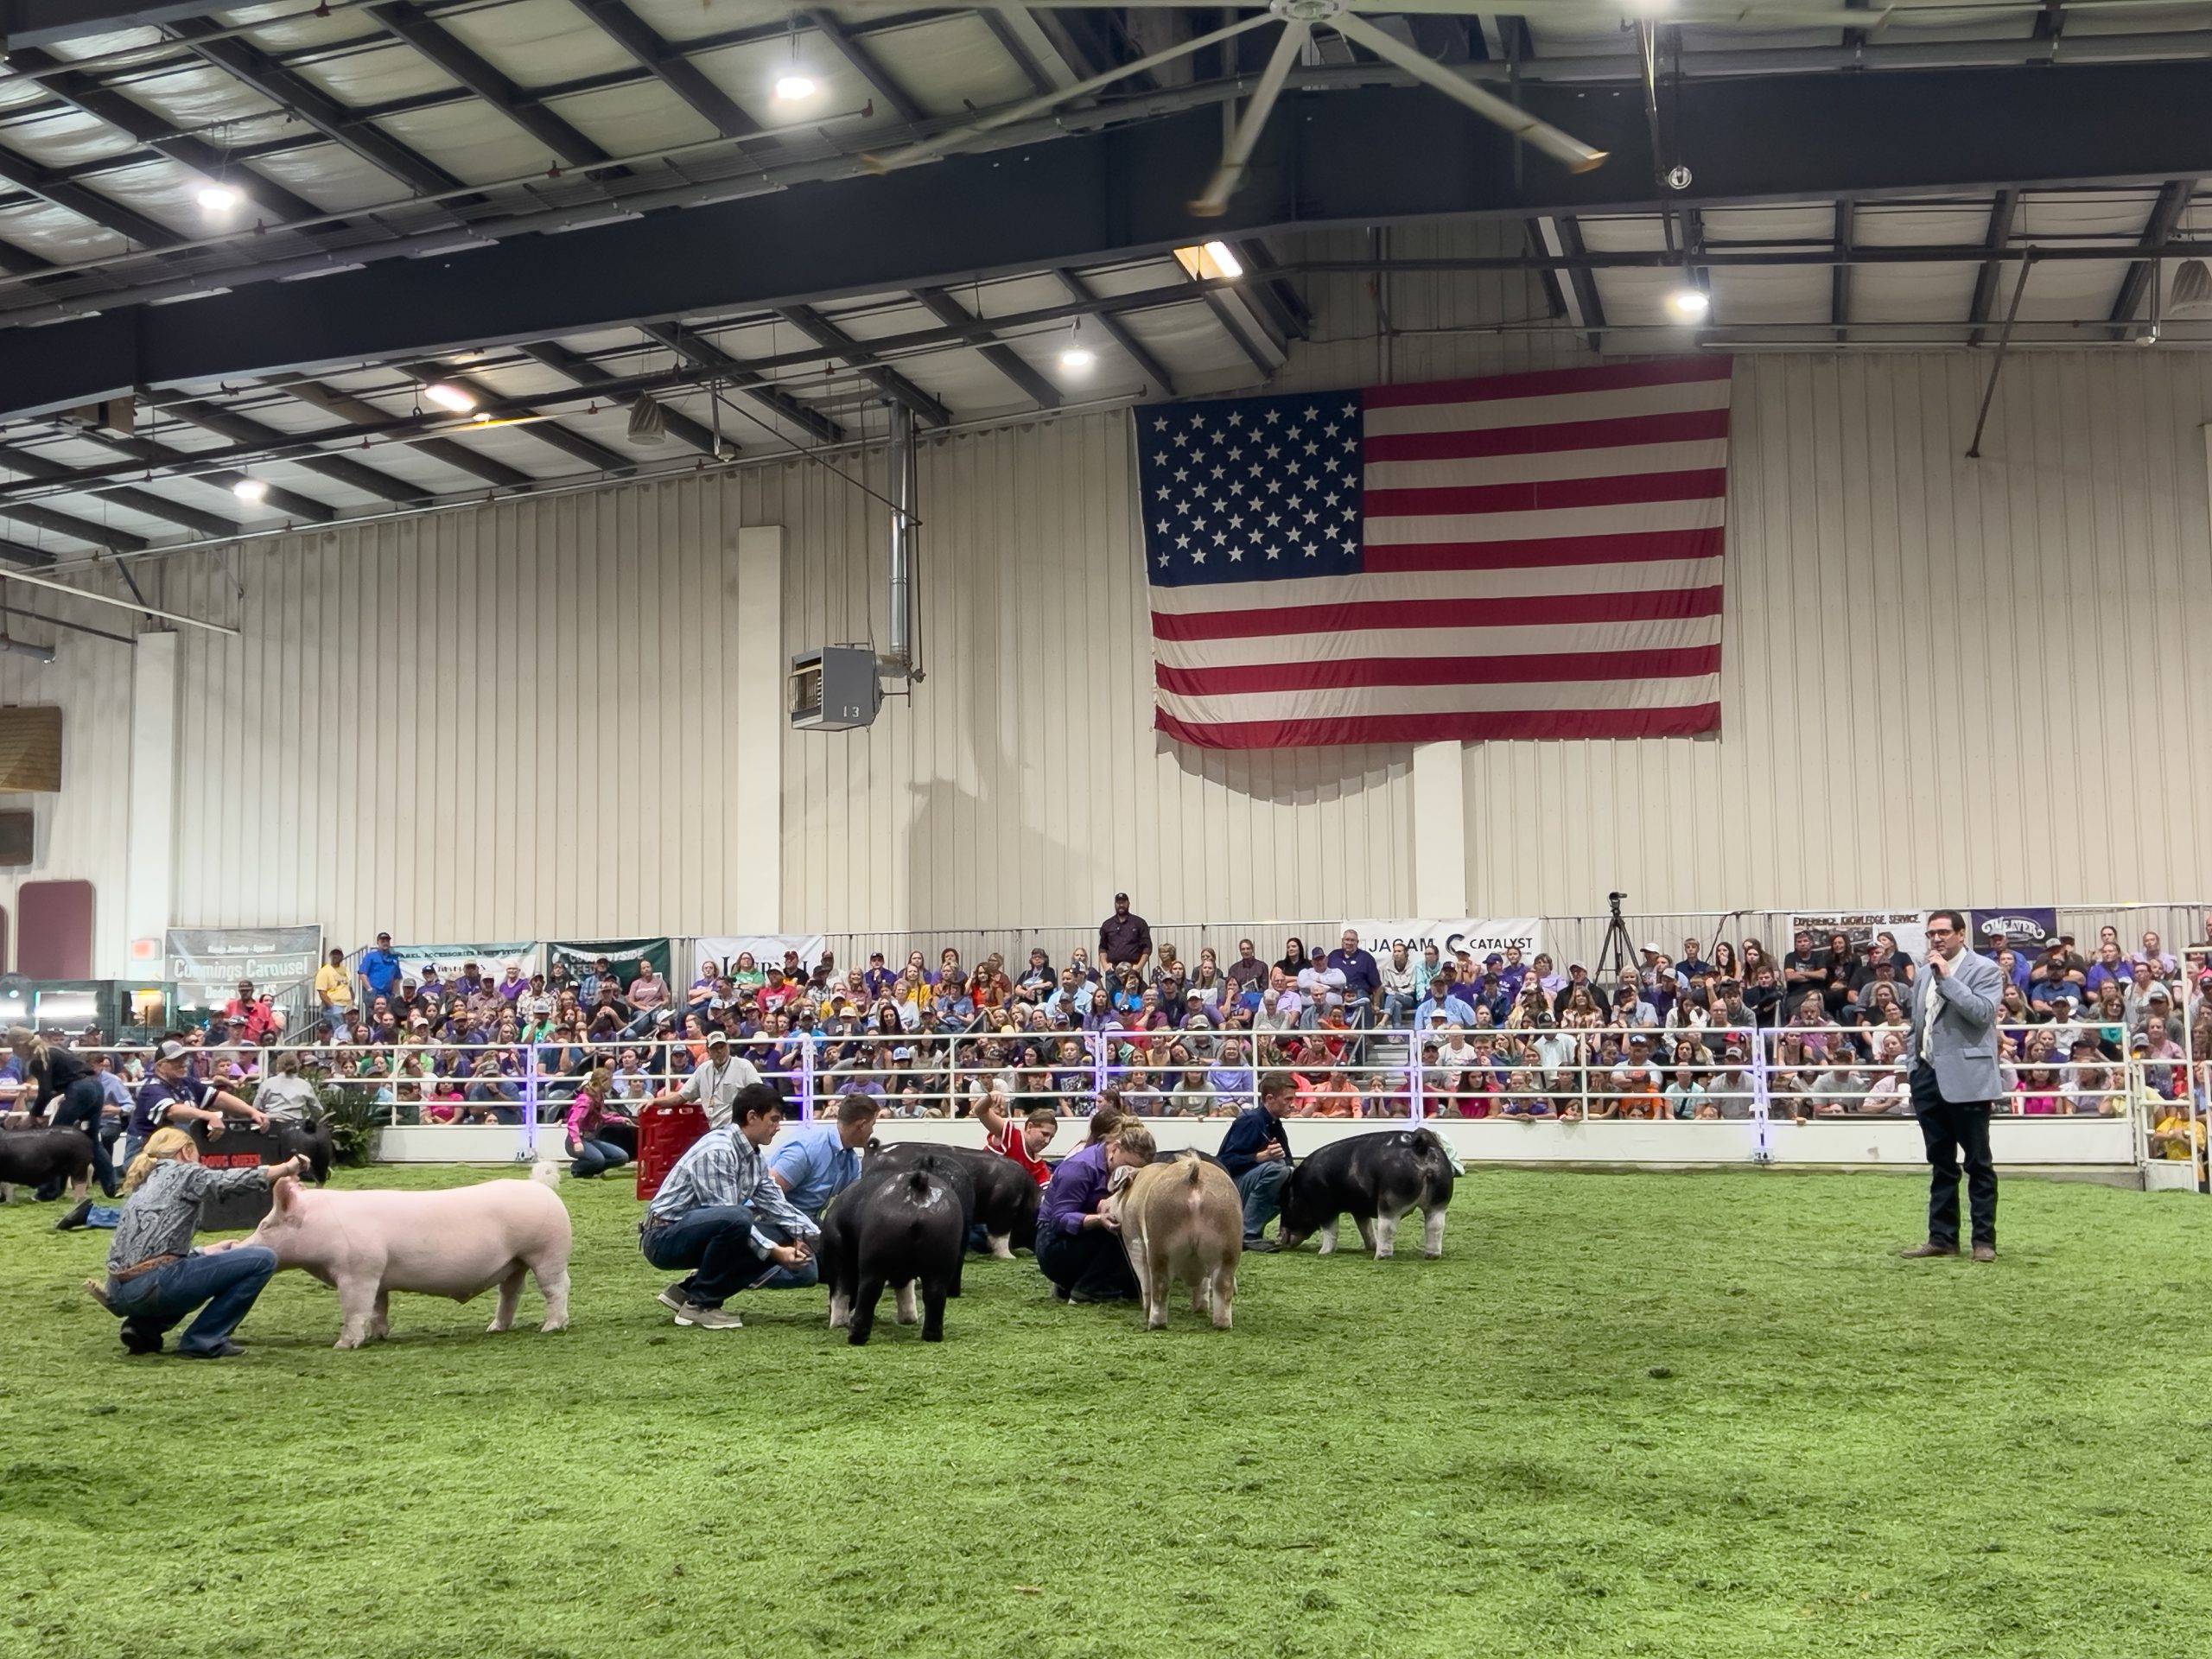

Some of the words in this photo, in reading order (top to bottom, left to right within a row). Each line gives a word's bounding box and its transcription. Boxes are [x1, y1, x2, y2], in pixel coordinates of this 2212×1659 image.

[843, 705, 860, 718] 13
[1794, 917, 1839, 926] EXPERIENCE.
[1840, 915, 1886, 925] KNOWLEDGE.
[1889, 914, 1921, 925] SERVICE.
[1981, 916, 2045, 939] WEAVER
[1470, 938, 1533, 950] CATALYST
[174, 959, 243, 982] Cummings
[246, 956, 308, 978] Carousel
